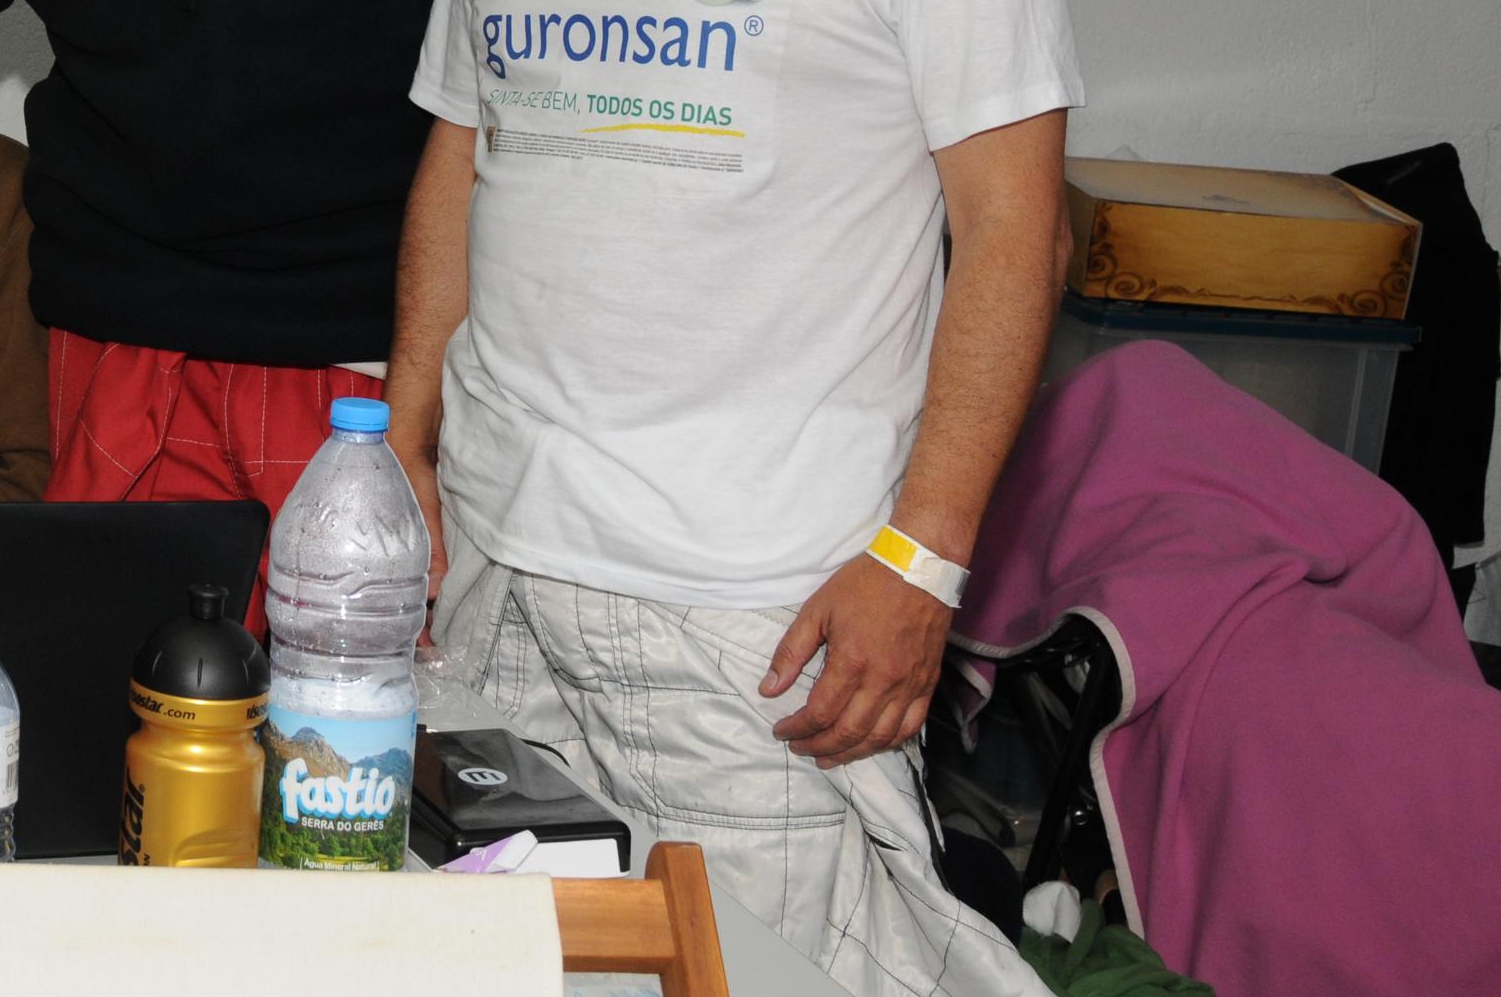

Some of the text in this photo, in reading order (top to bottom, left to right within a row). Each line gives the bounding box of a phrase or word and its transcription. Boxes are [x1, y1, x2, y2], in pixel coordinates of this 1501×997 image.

[541, 90, 581, 115] BEM,
[587, 94, 644, 117] TODOS
[648, 99, 676, 120] OS
[680, 103, 733, 126] DIAS
[280, 757, 398, 825] fastio
[301, 816, 385, 832] SERRA DO GERÊS
